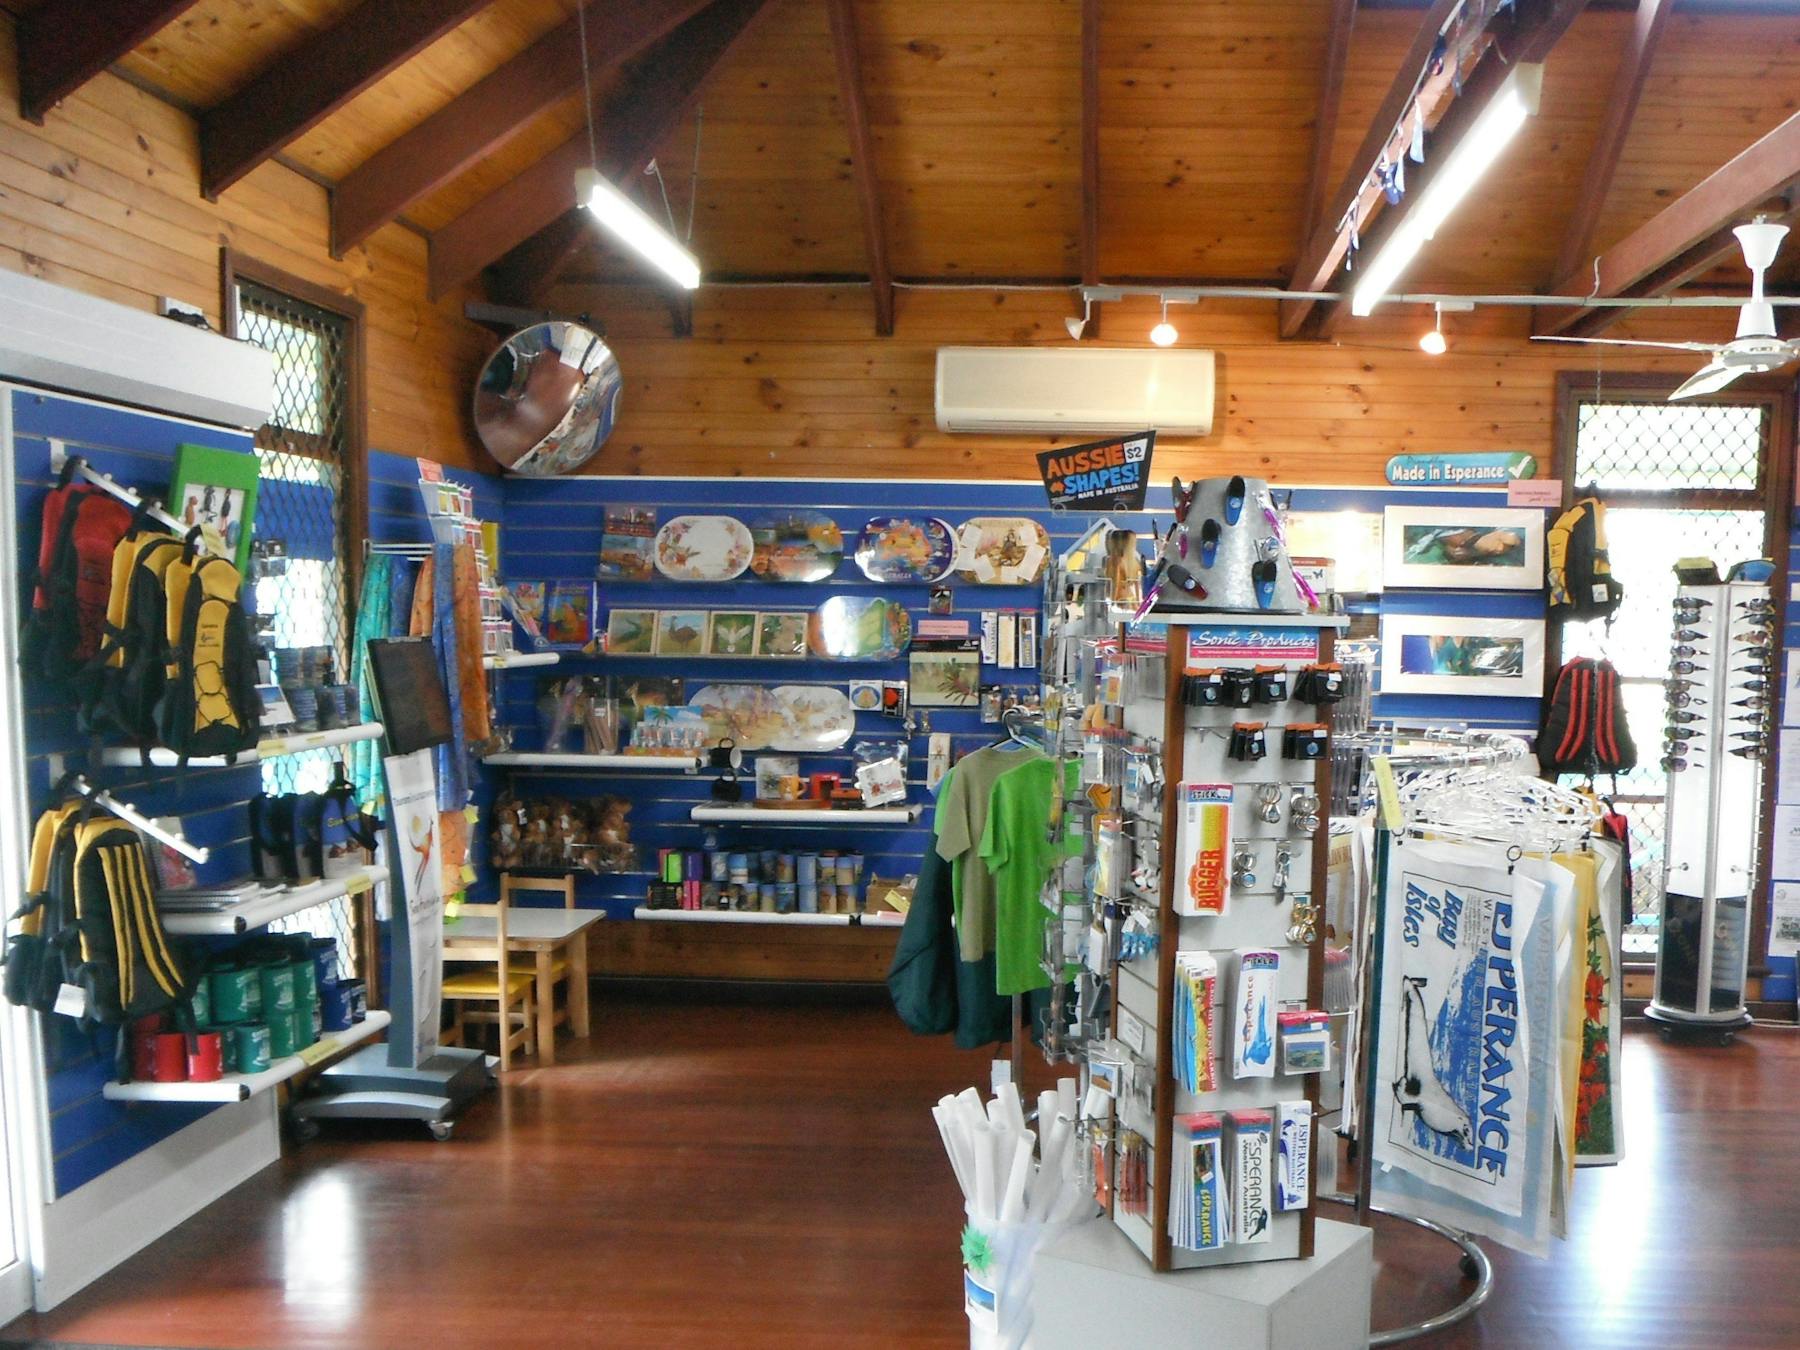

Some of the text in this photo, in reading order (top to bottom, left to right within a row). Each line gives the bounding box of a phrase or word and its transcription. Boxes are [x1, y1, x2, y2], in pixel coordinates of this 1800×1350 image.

[1047, 443, 1125, 479] AUSSIE
[1126, 446, 1142, 460] $2
[1392, 463, 1505, 482] Made in Esperance
[1063, 462, 1140, 495] SHAPES!
[1078, 491, 1095, 500] MADE
[1096, 489, 1103, 497] IN
[1104, 483, 1139, 496] AUSTRALIA
[1192, 630, 1316, 648] Sonic Products
[1197, 848, 1221, 909] BUGGER
[1402, 882, 1428, 948] Isles
[1424, 896, 1443, 921] of
[1437, 890, 1464, 950] Bay
[1243, 975, 1255, 1042] Esperance
[1297, 1124, 1309, 1192] ESPERANCE
[1249, 1138, 1264, 1226] ESPERANCE
[1200, 1189, 1212, 1246] ESPERANCE
